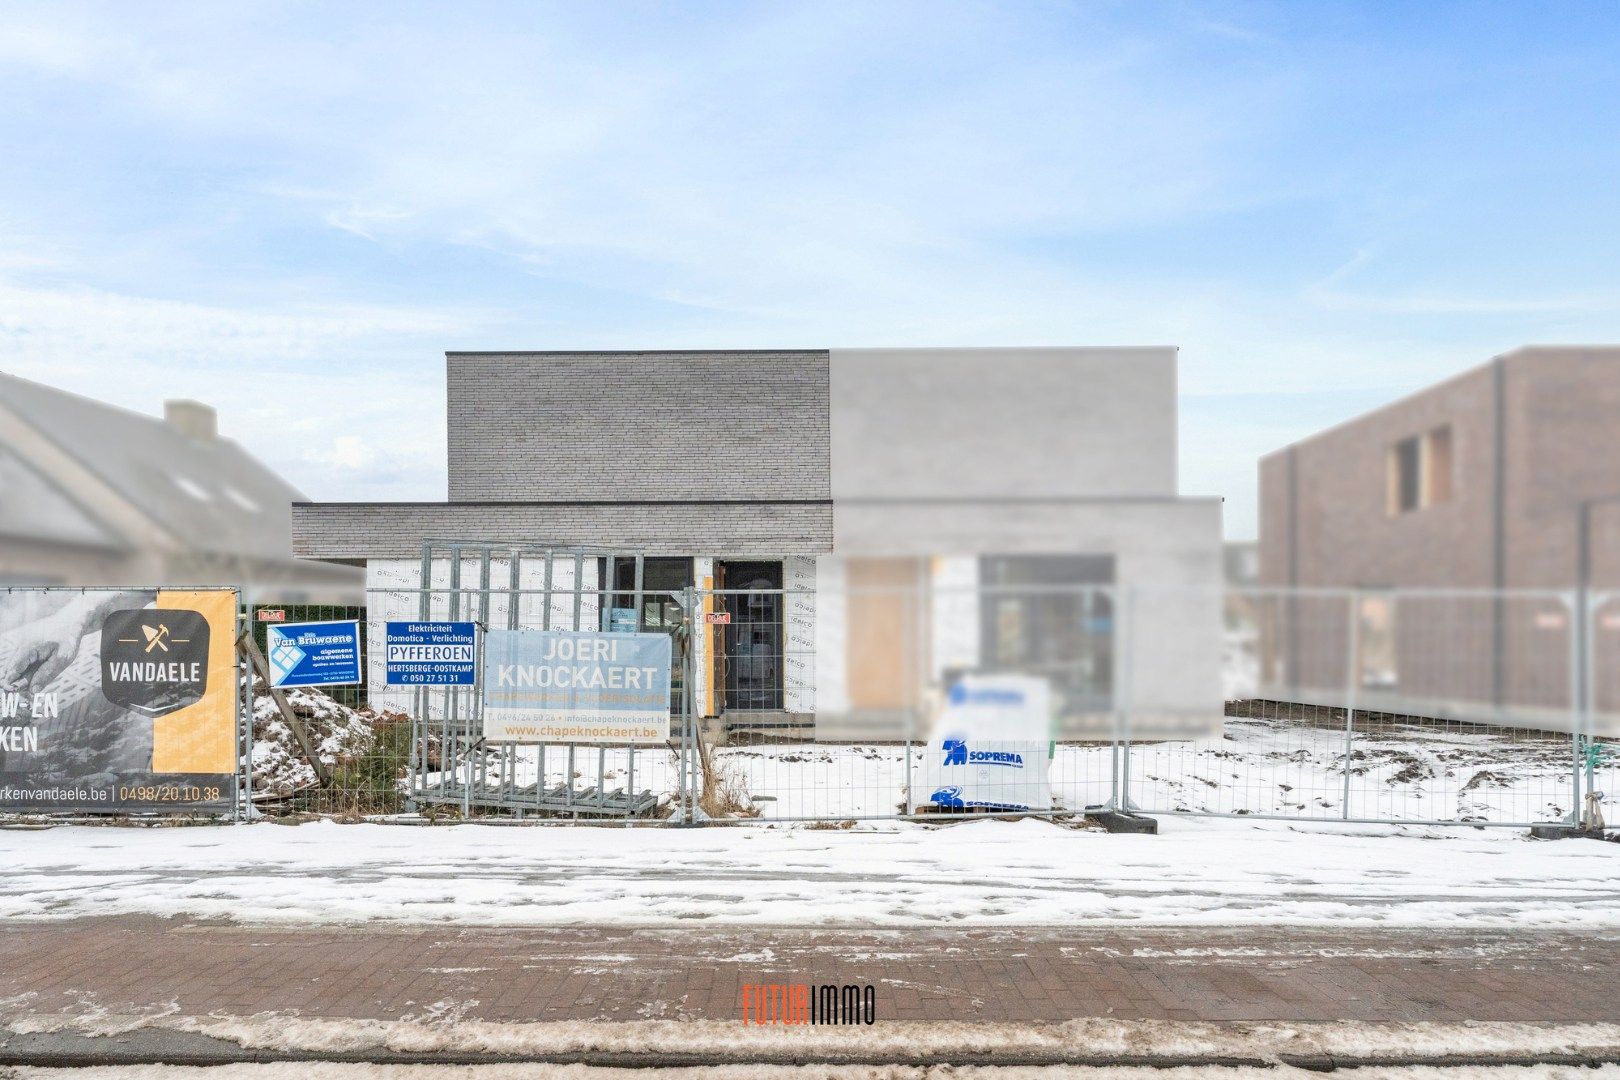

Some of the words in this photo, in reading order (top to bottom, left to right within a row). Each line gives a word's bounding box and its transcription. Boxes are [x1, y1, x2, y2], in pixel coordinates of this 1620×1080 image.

[408, 624, 452, 633] Elektriciteit
[274, 638, 296, 647] Van
[298, 634, 352, 646] Bruwaene
[432, 634, 473, 643] Verlichting
[390, 646, 471, 660] PYFFEROEN
[543, 638, 617, 661] JOERI
[388, 664, 473, 672] HERTSBERGE-OOSTKAMP
[786, 657, 806, 669] delco
[109, 662, 200, 682] VANDAELE
[498, 664, 658, 690] KNOCKAERT
[32, 693, 58, 718] EN
[505, 725, 658, 738] www.chapeknockaert.be
[969, 751, 1023, 764] SOPREMA
[120, 787, 220, 802] 0498/20.10.38
